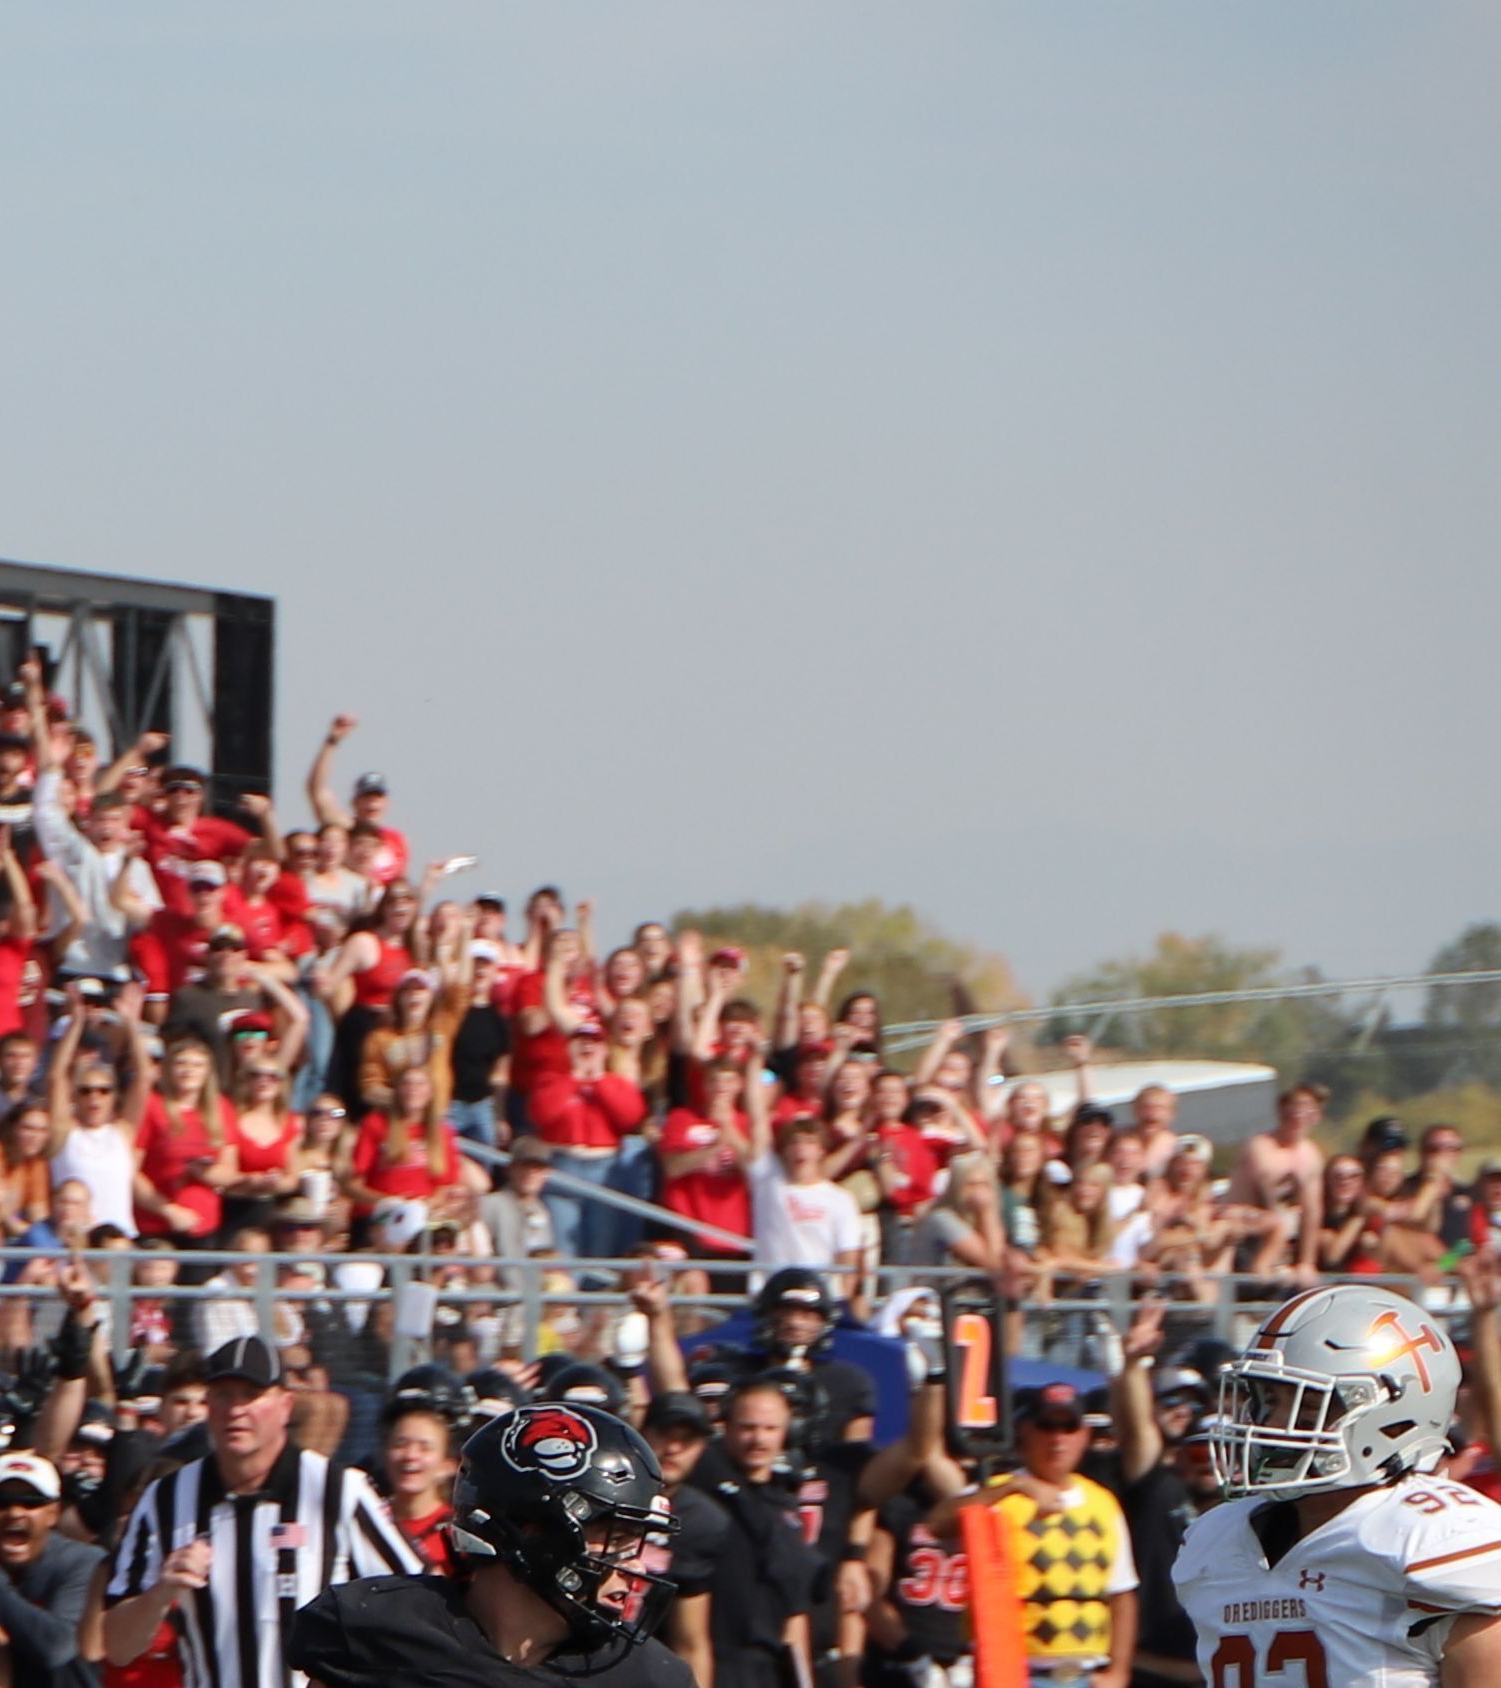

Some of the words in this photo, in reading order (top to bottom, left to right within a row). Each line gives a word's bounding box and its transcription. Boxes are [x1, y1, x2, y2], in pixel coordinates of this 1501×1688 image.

[953, 1314, 997, 1428] 2
[1400, 1484, 1481, 1515] 92
[1223, 1598, 1307, 1625] OREDIGGERS
